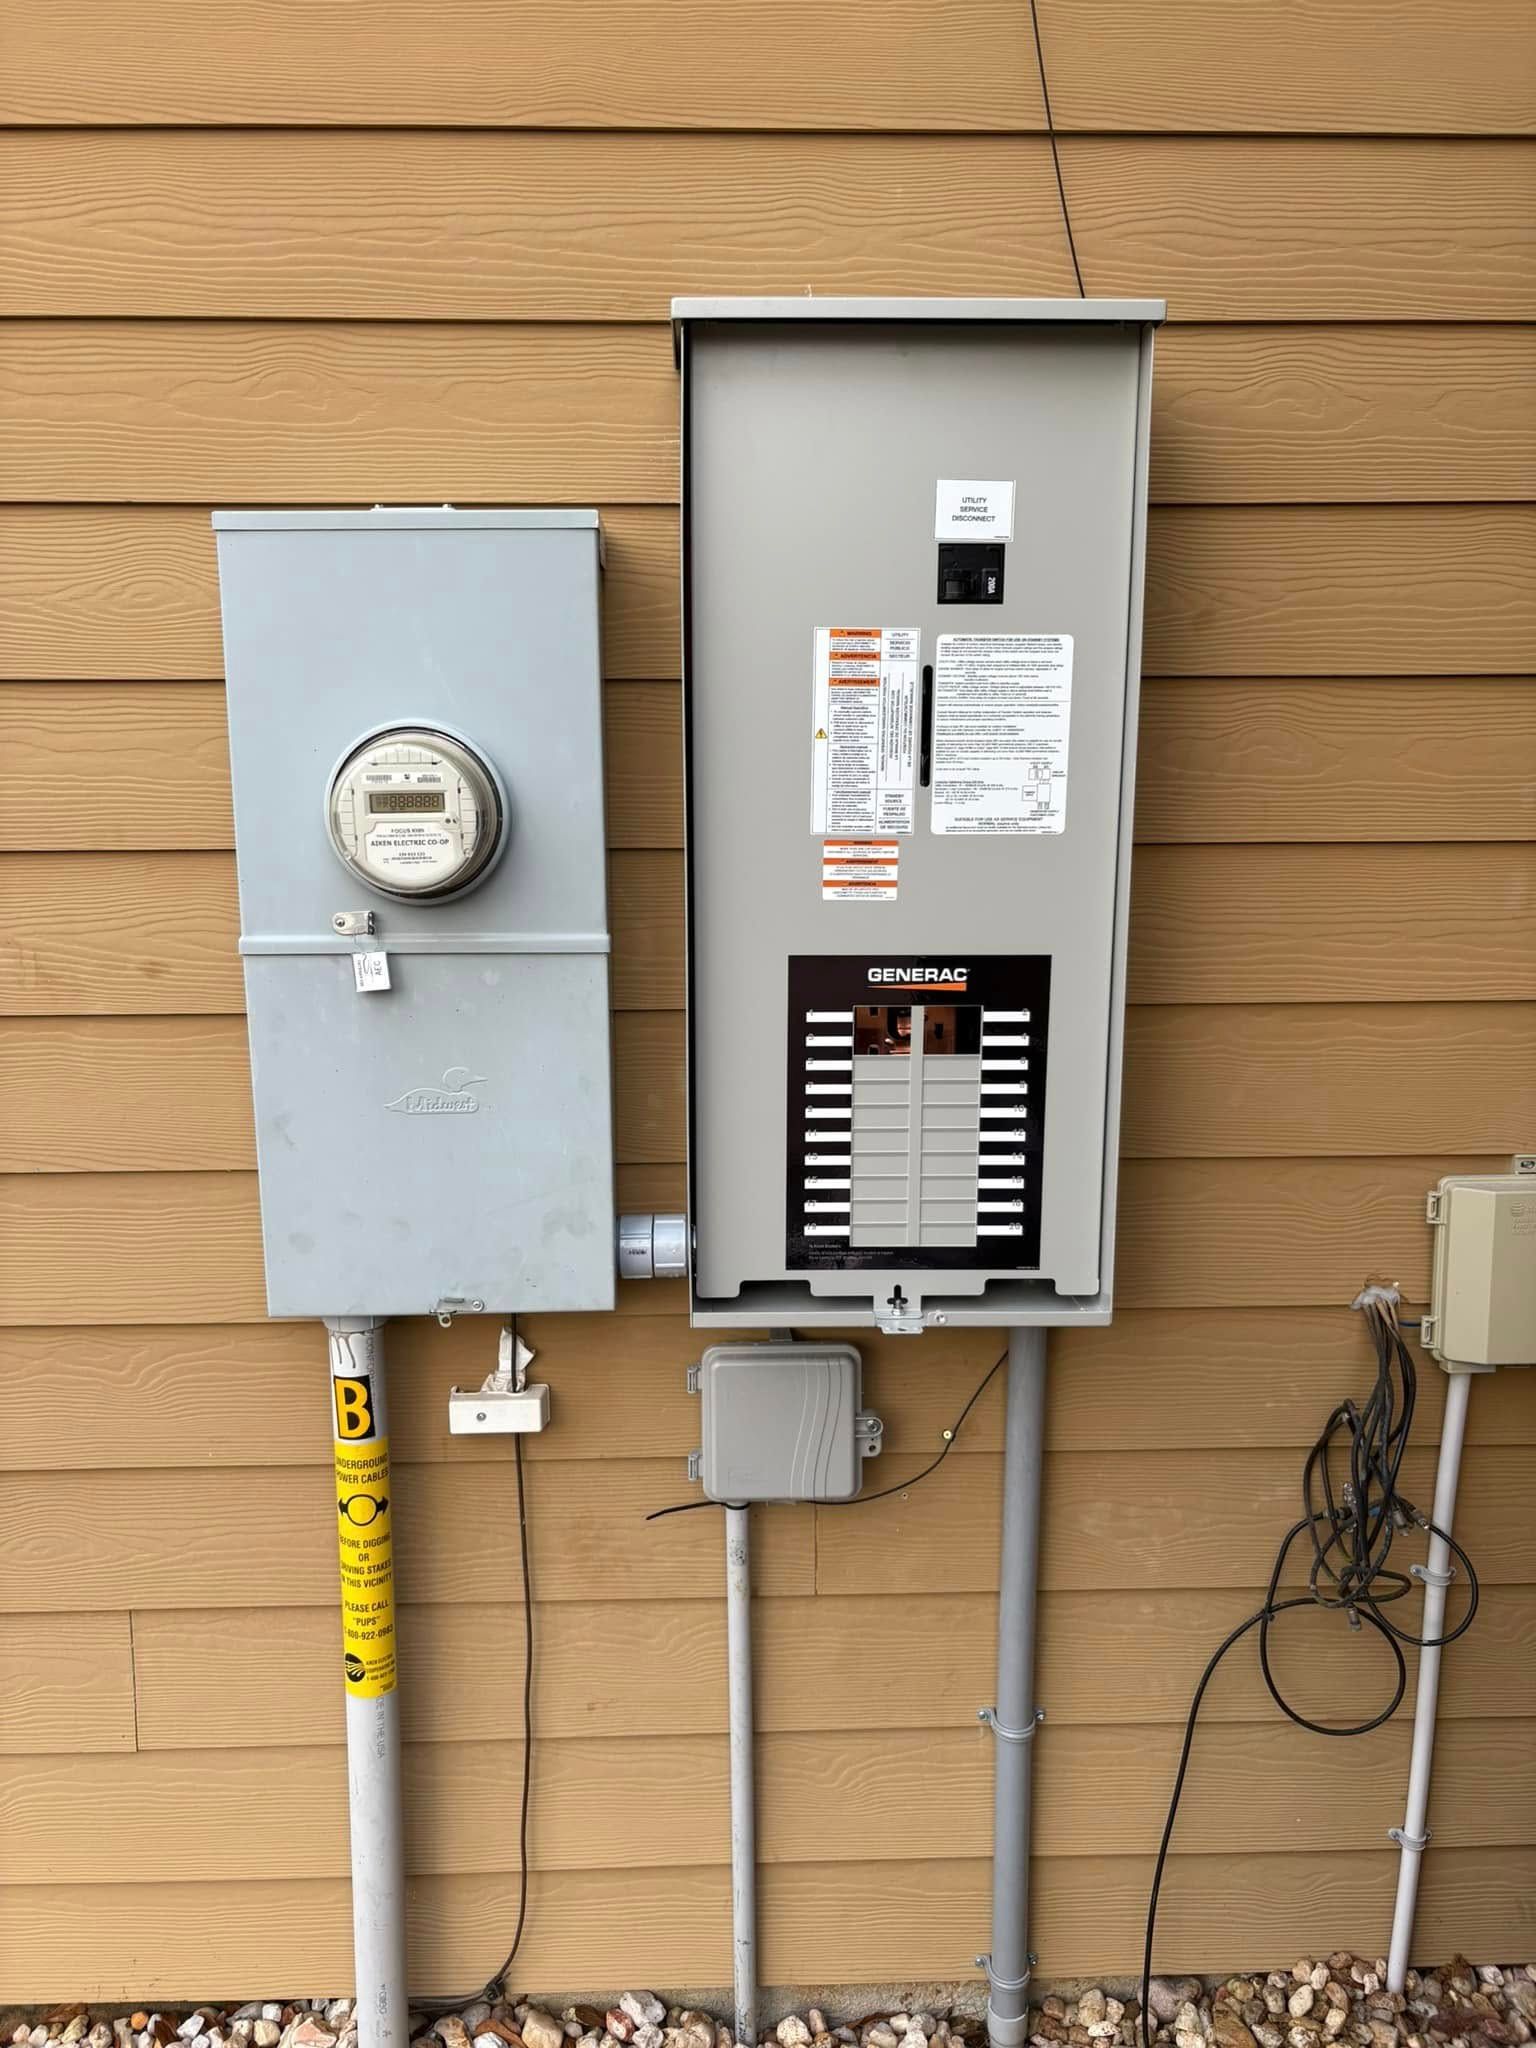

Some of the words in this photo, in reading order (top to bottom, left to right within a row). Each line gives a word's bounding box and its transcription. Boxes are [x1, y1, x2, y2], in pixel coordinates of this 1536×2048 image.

[868, 968, 968, 982] GENERAC
[336, 1378, 371, 1438] B
[361, 1468, 388, 1484] CABLES
[340, 1535, 360, 1548] EFORE
[358, 1553, 370, 1562] OR
[347, 1577, 361, 1588] THIS
[345, 1600, 369, 1612] PLEASE
[372, 1600, 388, 1611] CALL
[352, 1616, 380, 1626] "PUPS"
